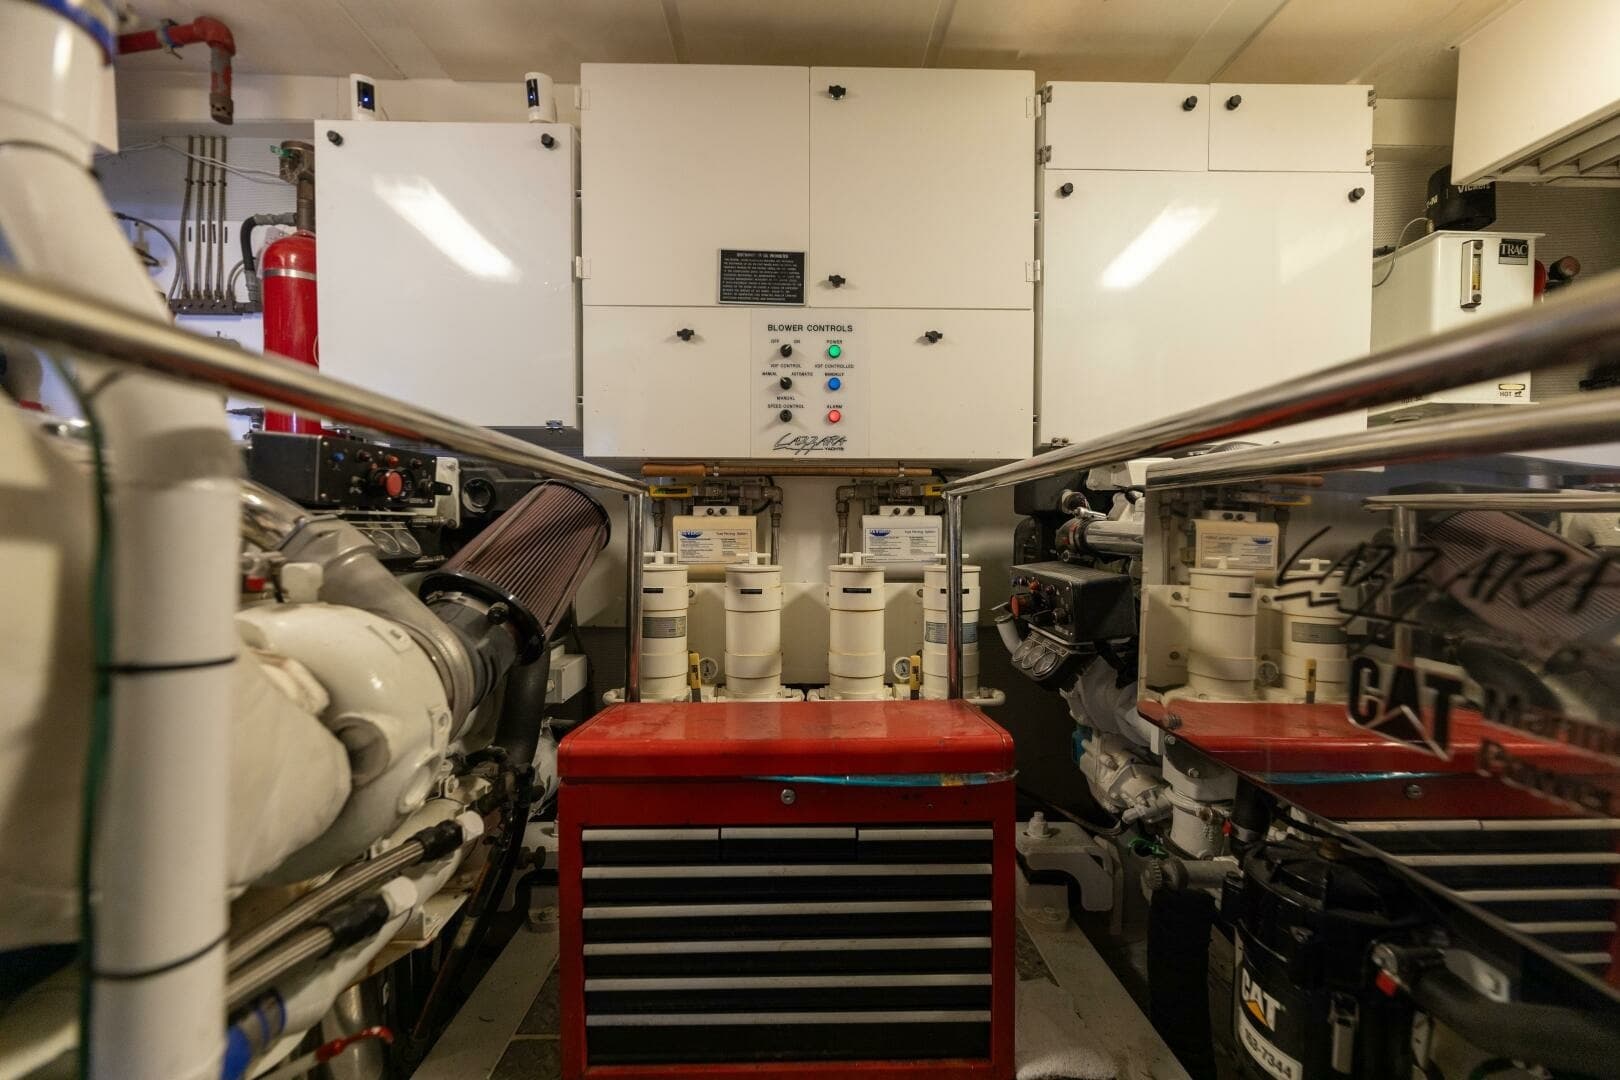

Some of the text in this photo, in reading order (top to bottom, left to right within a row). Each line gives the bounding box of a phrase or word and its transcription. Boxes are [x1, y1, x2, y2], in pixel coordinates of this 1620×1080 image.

[1501, 243, 1528, 256] TRAC
[767, 324, 853, 332] BLOWER CONTROLS
[1350, 655, 1465, 755] CAT
[1241, 967, 1286, 1033] CAT
